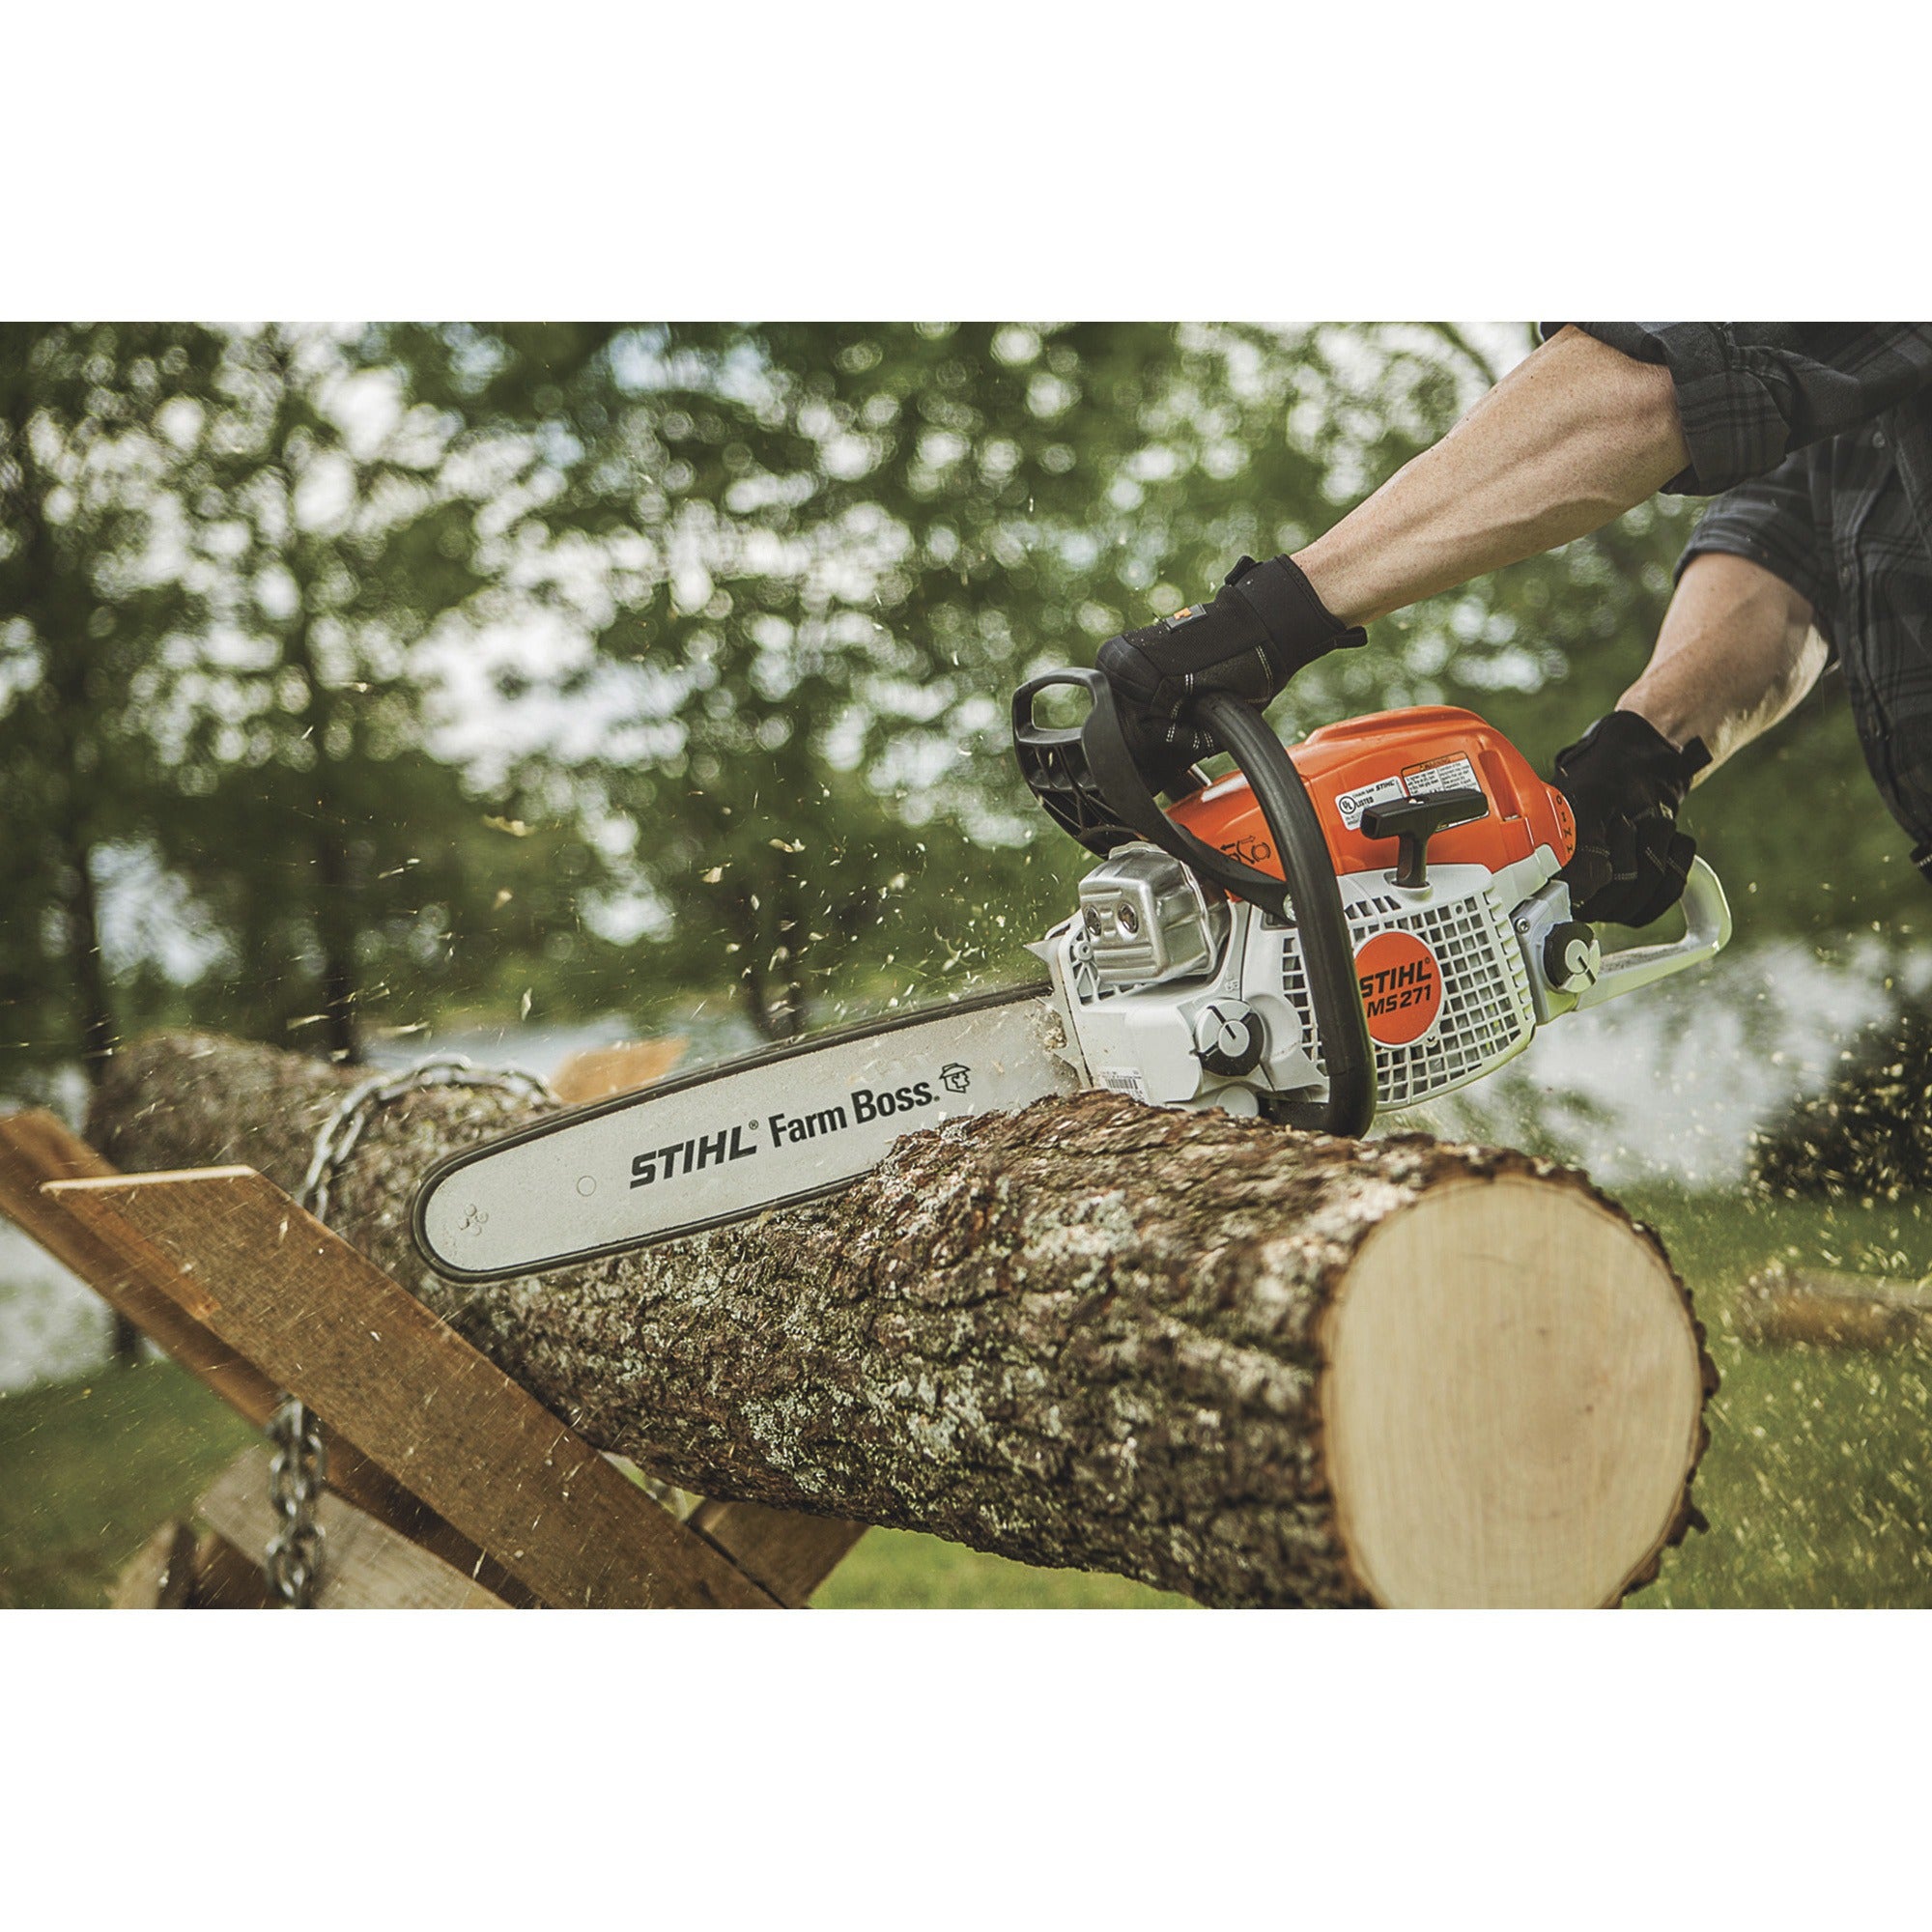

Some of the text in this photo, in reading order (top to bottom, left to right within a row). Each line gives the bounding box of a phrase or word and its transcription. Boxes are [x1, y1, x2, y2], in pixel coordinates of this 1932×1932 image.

[1376, 779, 1395, 791] STIHL
[1355, 796, 1374, 808] LISTED
[1358, 959, 1433, 999] STIHL
[629, 1125, 757, 1190] STIHL
[768, 1106, 848, 1149] Farm
